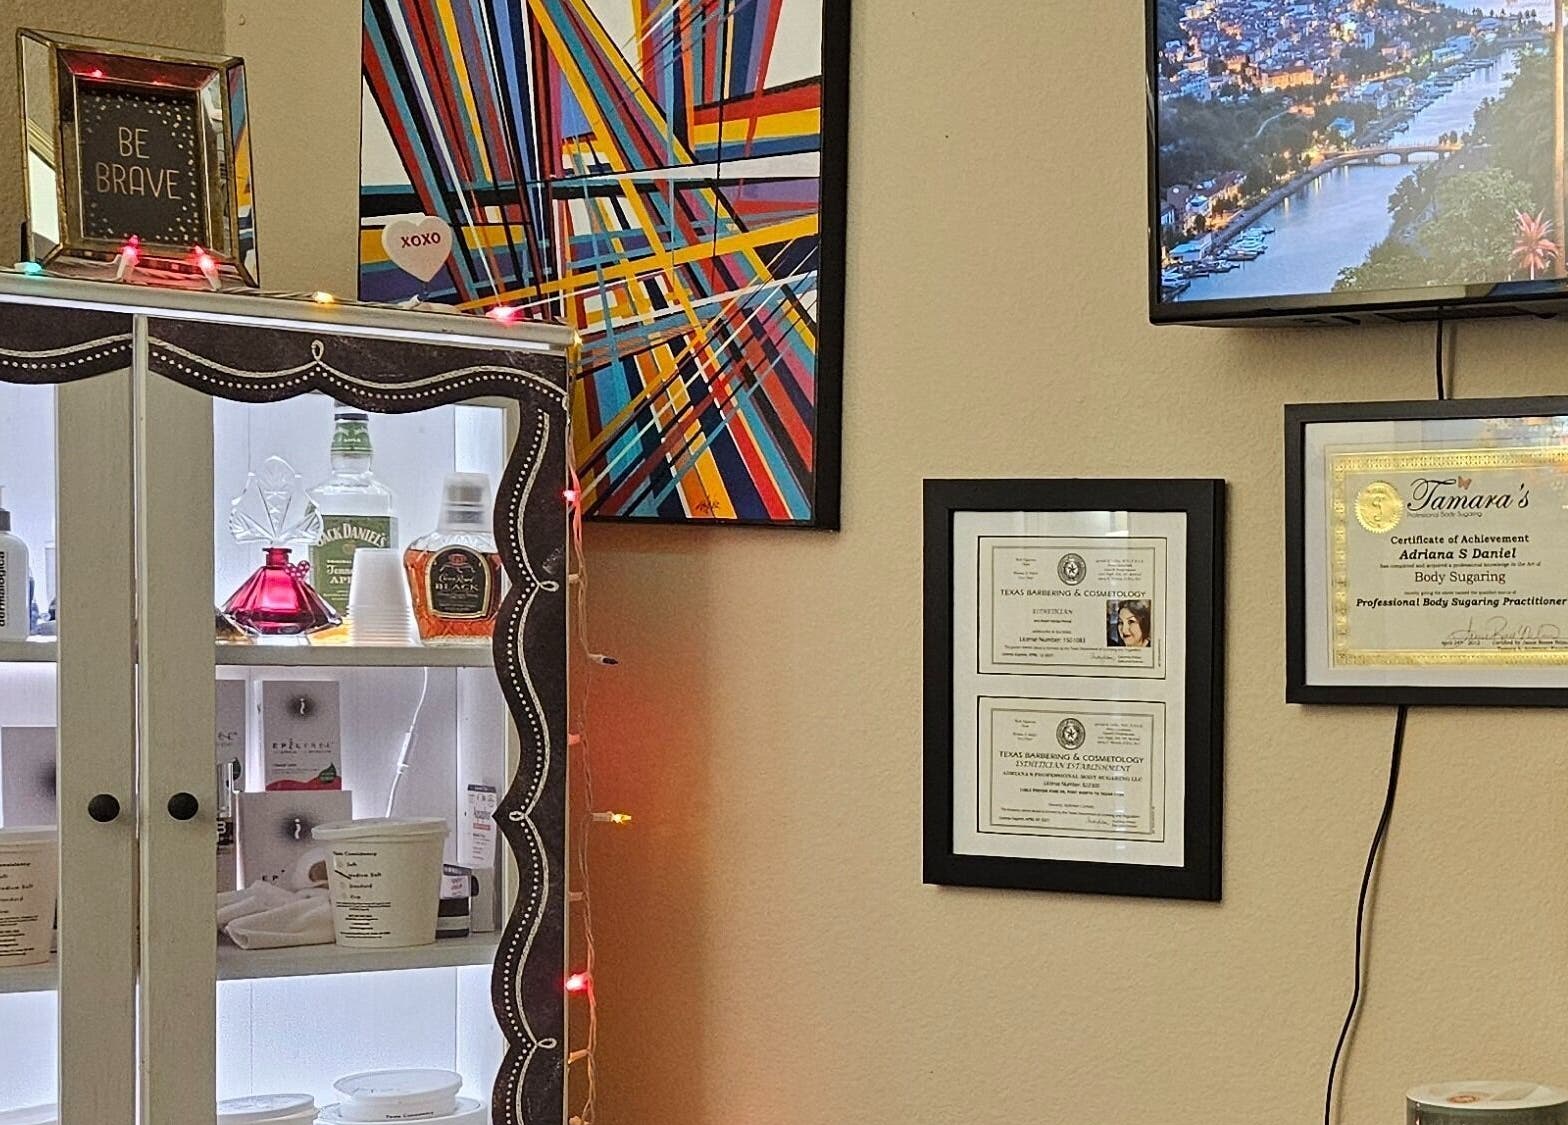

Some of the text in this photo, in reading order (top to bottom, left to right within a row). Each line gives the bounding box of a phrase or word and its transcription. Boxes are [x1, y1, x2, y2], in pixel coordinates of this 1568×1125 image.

[118, 126, 150, 159] BE
[95, 161, 182, 200] BRAVE
[400, 231, 442, 249] XOXO
[1407, 478, 1530, 512] Tamara's
[342, 523, 387, 548] DANIEL'S
[1390, 534, 1530, 545] Certificate of Achievement
[1399, 547, 1517, 560] Adriana S Daniel
[1414, 571, 1506, 585] Body Sugaring
[1000, 588, 1146, 598] TEXAS BARBERING & COSMETOLOGY
[1355, 597, 1568, 609] Professional Body Sugaring Practitioner
[999, 750, 1145, 764] TEXAS BARBERING & COSMETOLOGY
